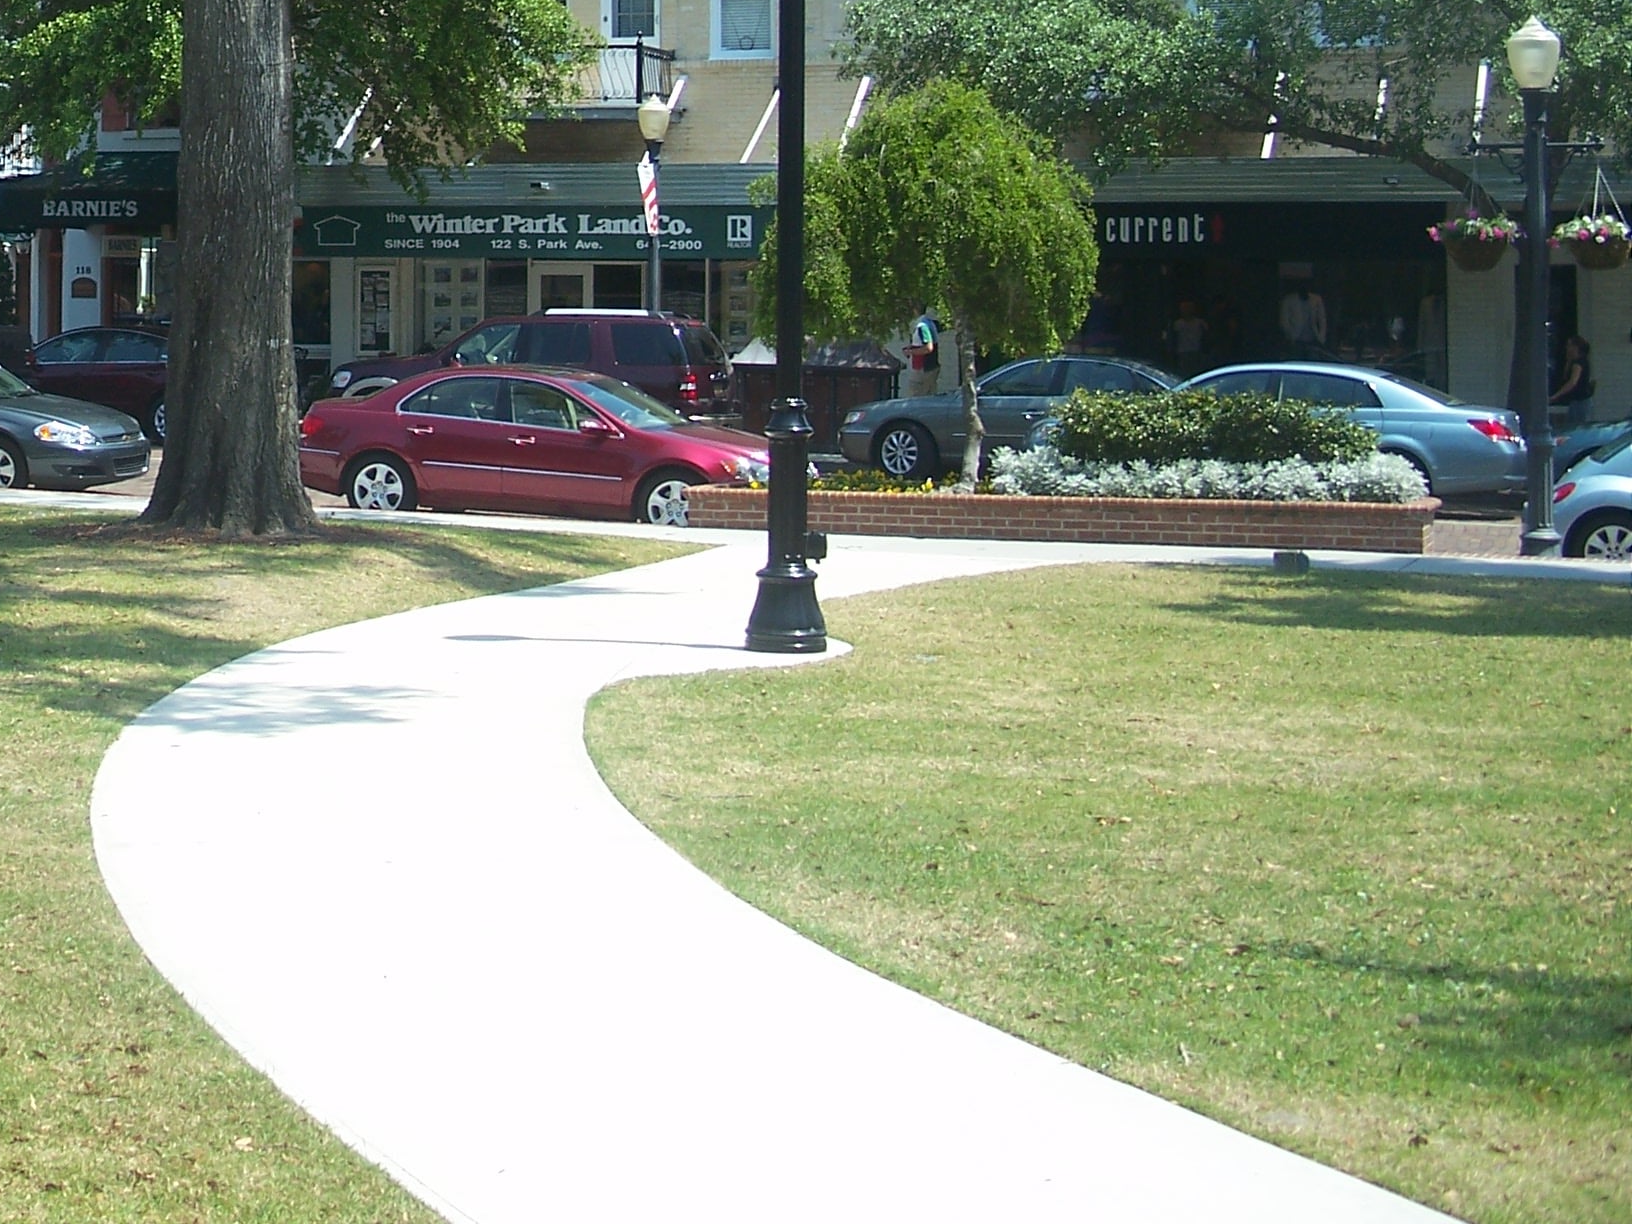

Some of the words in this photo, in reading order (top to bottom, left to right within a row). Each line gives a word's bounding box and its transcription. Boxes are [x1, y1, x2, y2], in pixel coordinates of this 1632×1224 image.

[43, 200, 138, 217] BARNIE'S
[386, 212, 406, 223] the
[408, 213, 499, 234] Winter
[501, 213, 568, 234] Park
[577, 214, 646, 235] Land
[658, 214, 693, 235] Co.
[1105, 213, 1205, 243] current
[384, 239, 425, 249] SINCE
[431, 239, 460, 249] 1904
[490, 239, 512, 249] 122
[517, 239, 532, 249] S.
[537, 239, 568, 249] Park
[575, 239, 604, 250] Ave.
